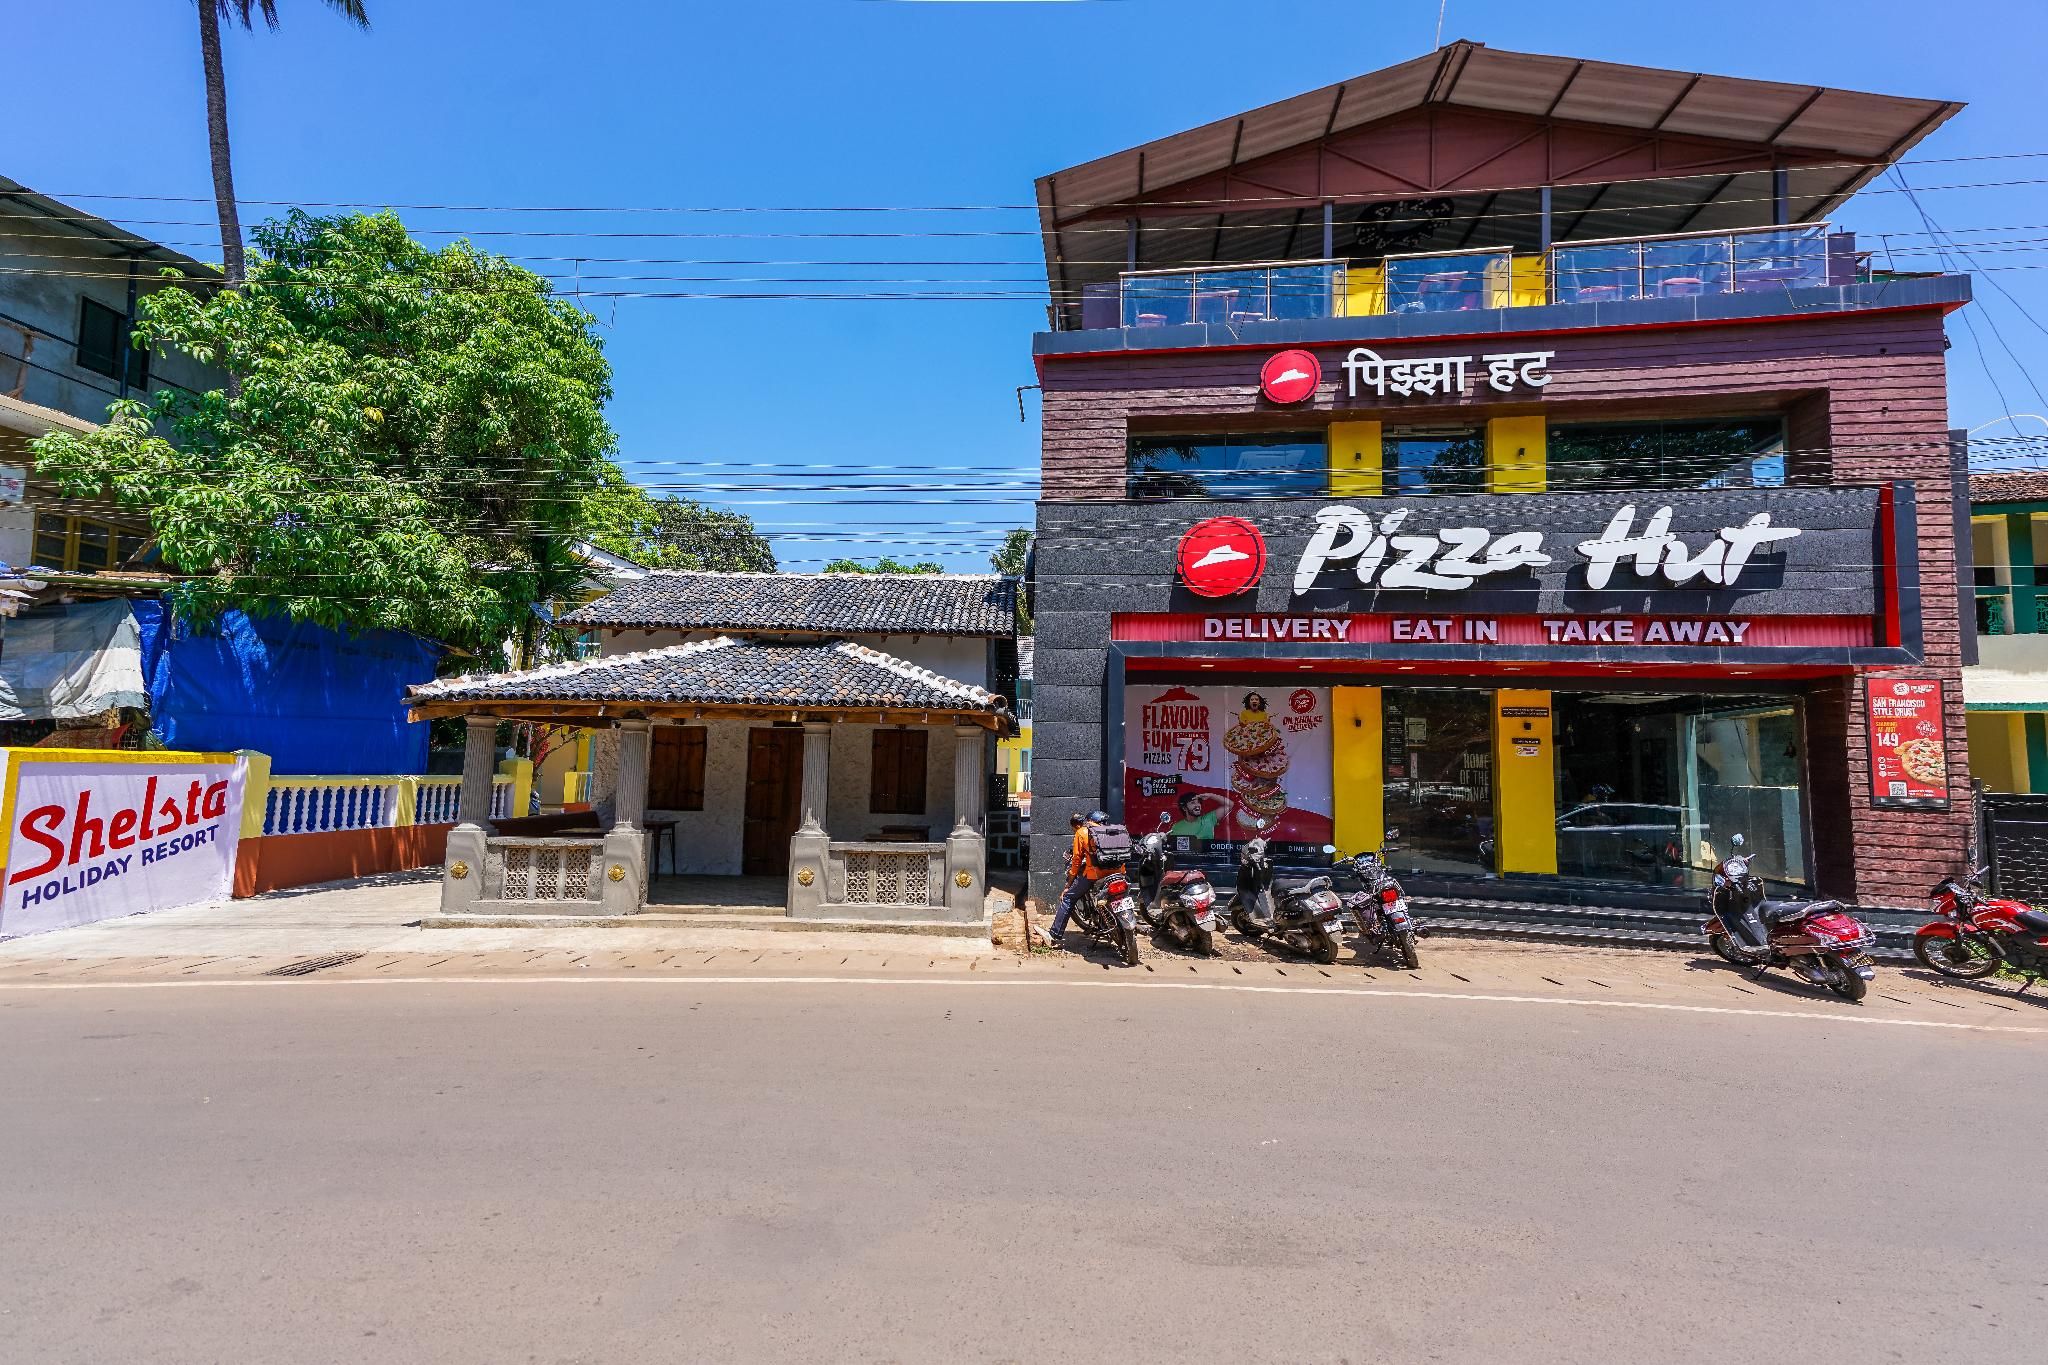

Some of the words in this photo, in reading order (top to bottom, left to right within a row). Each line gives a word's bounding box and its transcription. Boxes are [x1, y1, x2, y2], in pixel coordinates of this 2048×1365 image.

[1342, 348, 1472, 397] पिझ्झा
[1483, 350, 1555, 392] हट
[1293, 505, 1552, 596] Pizza
[1577, 504, 1802, 591] Hut
[1204, 618, 1352, 639] DELIVERY
[1392, 619, 1451, 641] EAT
[1464, 620, 1498, 642] IN
[1543, 620, 1635, 643] TAKE
[1644, 622, 1751, 644] AWAY
[1142, 704, 1210, 730] FLAVOUR
[1875, 732, 1899, 747] 149
[1143, 752, 1172, 765] PIZZAS
[1177, 738, 1210, 771] 79
[1463, 753, 1489, 769] HOME
[1472, 770, 1489, 786] THE
[8, 775, 228, 886] Shelsta
[21, 854, 133, 909] HOLIDAY
[141, 824, 219, 867] RESORT
